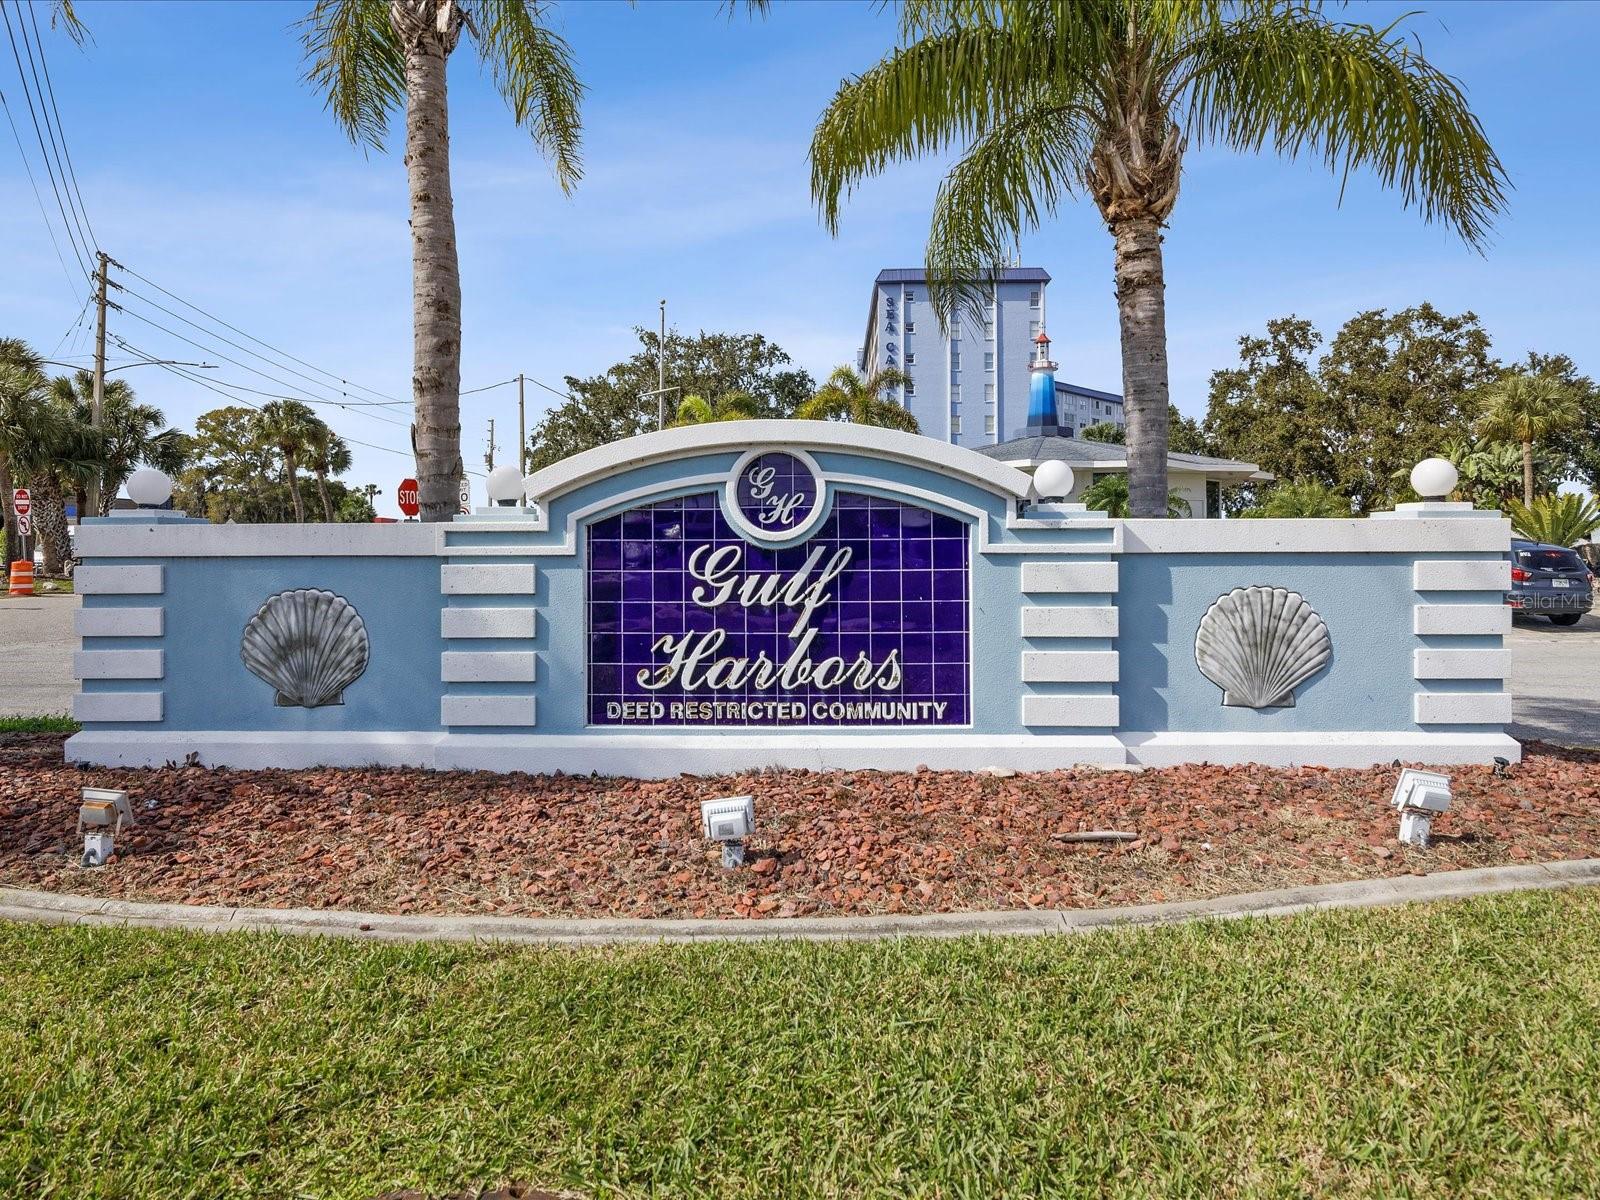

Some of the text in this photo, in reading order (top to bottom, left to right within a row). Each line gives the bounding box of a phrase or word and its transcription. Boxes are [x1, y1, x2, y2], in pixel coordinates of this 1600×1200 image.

[749, 467, 776, 499] G
[688, 544, 853, 638] Gulf
[637, 628, 901, 691] Harbors
[606, 702, 948, 720] DEED RESTRICTED COMMUNITY
